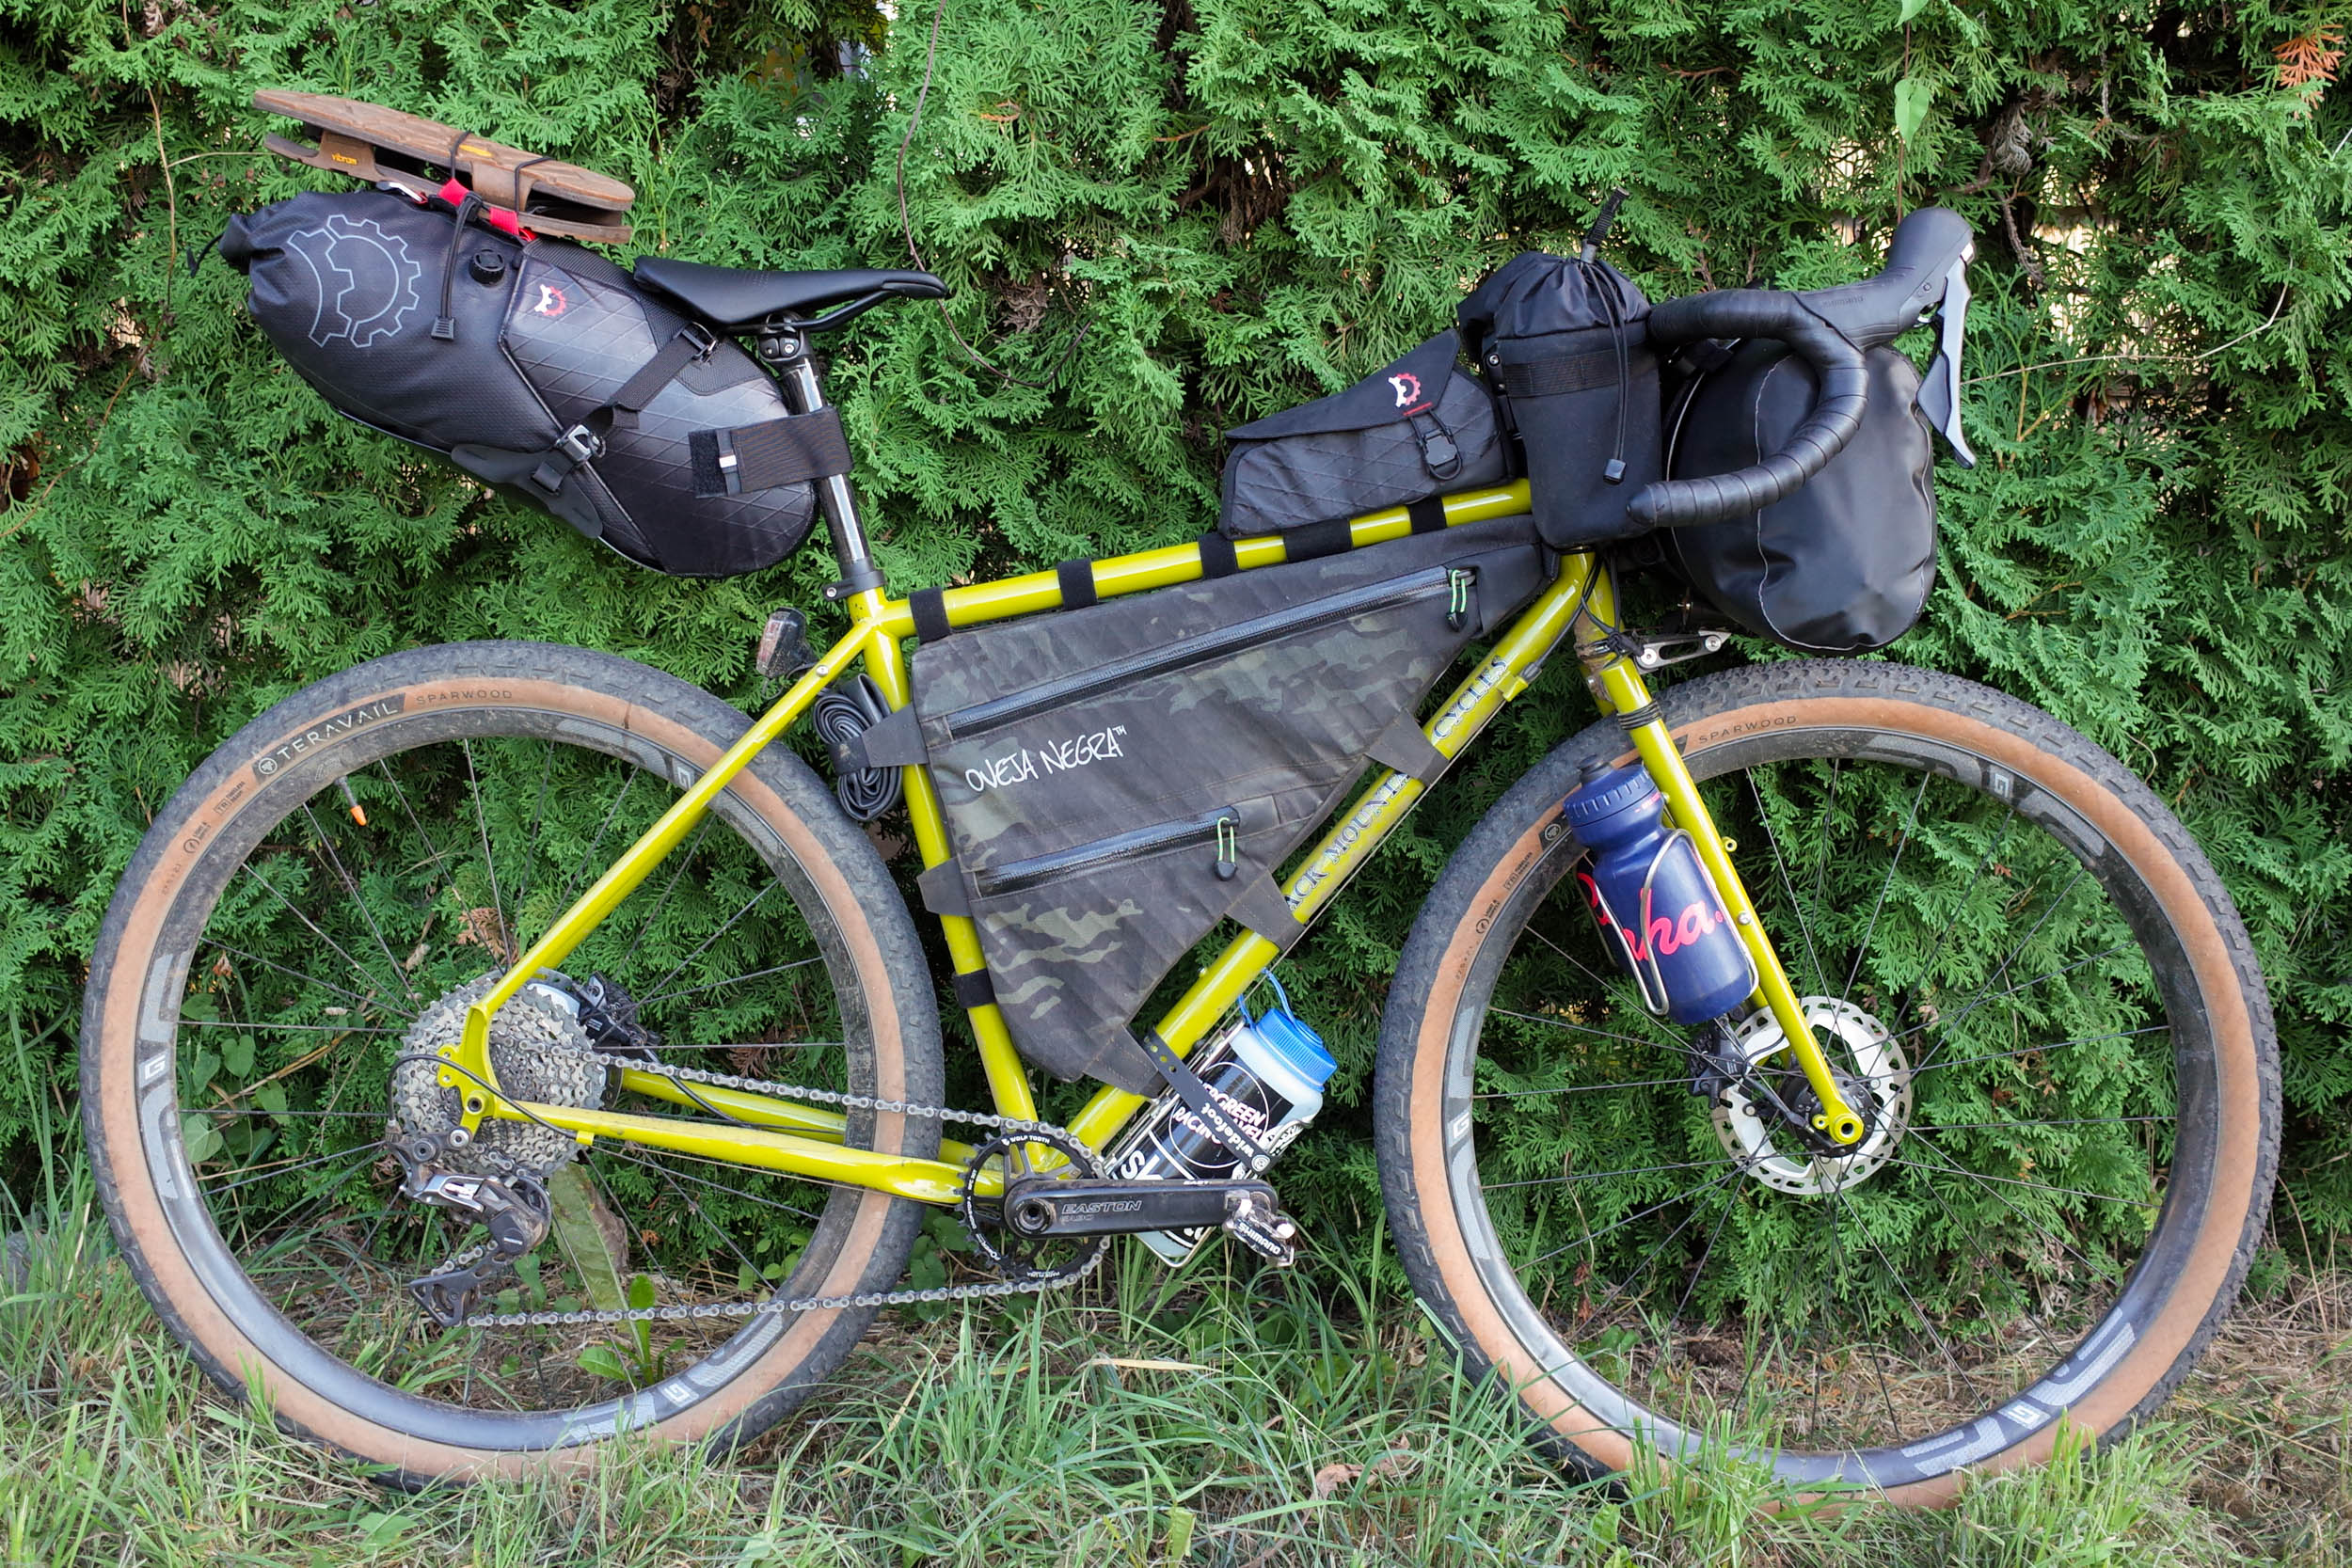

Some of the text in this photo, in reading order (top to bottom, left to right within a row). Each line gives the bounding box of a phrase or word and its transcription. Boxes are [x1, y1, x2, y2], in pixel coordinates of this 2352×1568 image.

[416, 689, 513, 705] SPARWOOD
[1433, 655, 1508, 739] CYCLES
[277, 703, 399, 761] TERAVAIL
[1698, 716, 1797, 744] SPARWOOD
[964, 749, 1040, 793] OVEJA
[1284, 863, 1329, 912] ACK
[1200, 1102, 1255, 1158] widefoot
[1061, 1200, 1142, 1214] EASTON
[1238, 1222, 1281, 1256] SHIMANO
